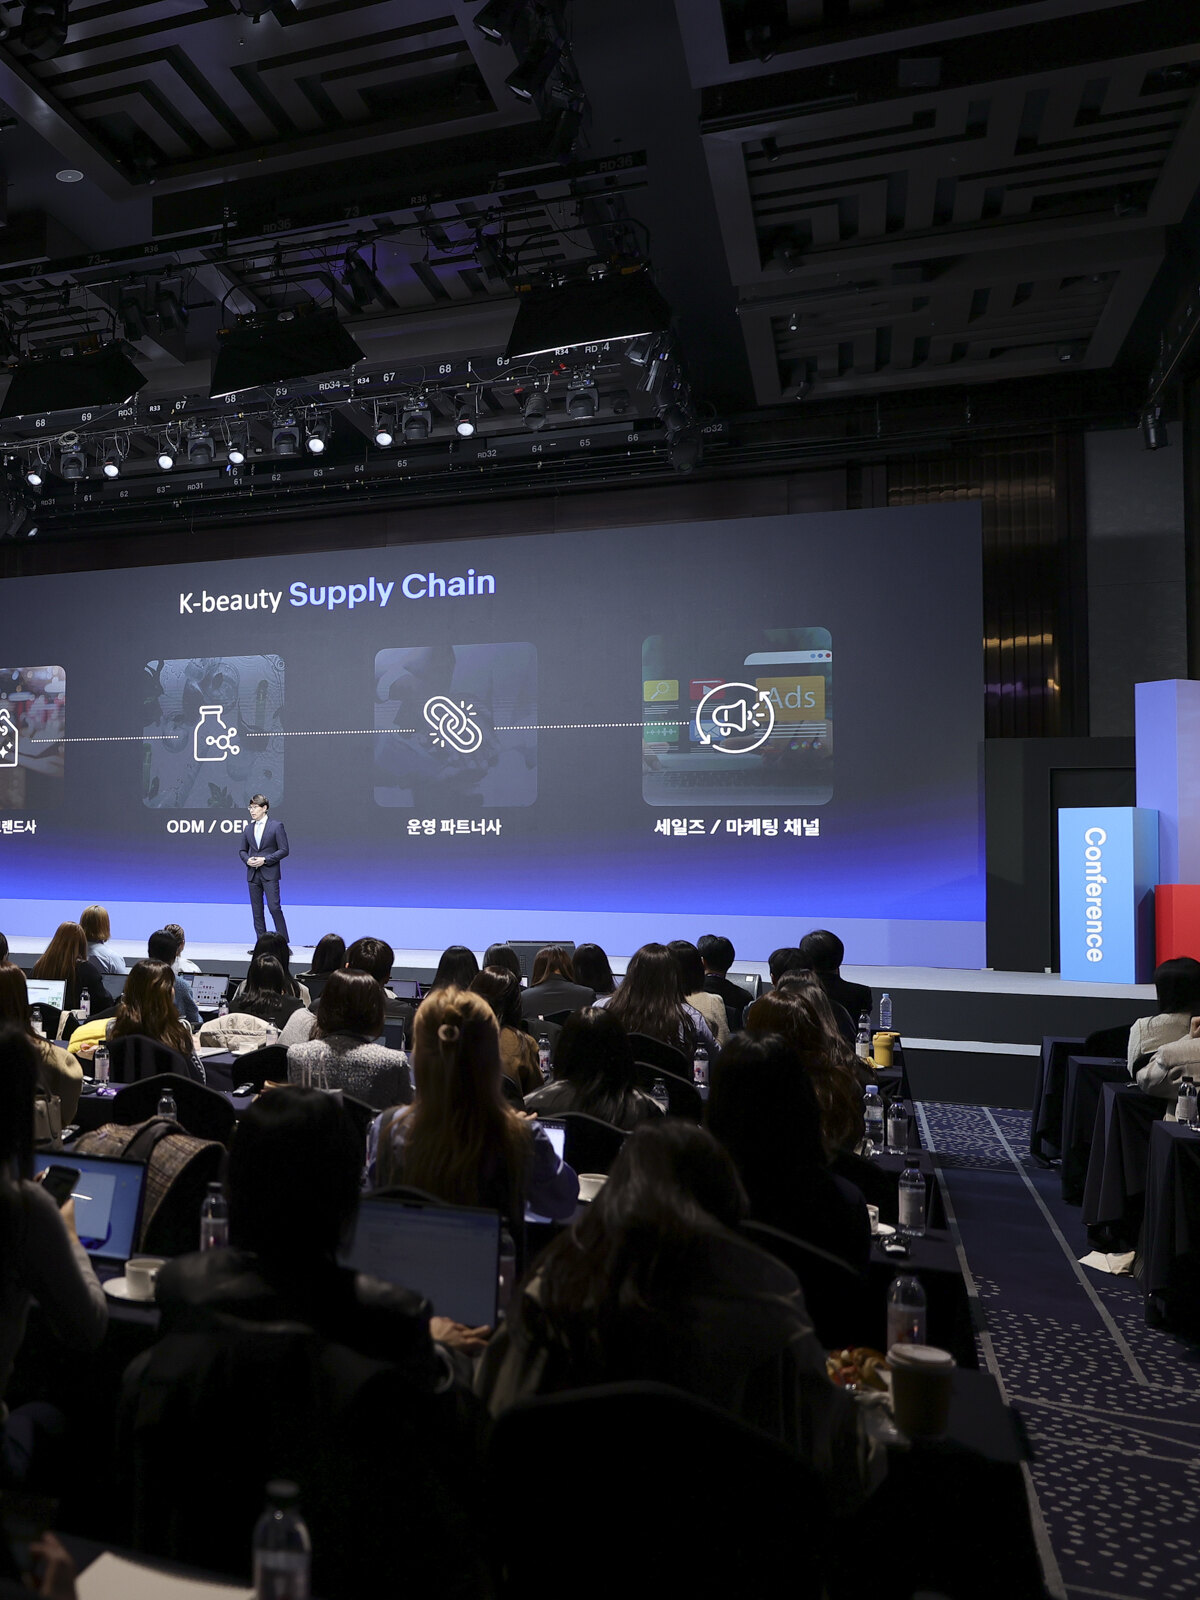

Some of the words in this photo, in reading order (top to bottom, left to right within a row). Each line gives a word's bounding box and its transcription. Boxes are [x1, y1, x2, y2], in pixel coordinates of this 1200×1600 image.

[600, 155, 633, 171] RD36
[489, 180, 505, 192] 75
[411, 194, 427, 205] R36
[263, 218, 291, 232] RD36
[144, 244, 158, 253] R36
[88, 255, 100, 265] 73
[30, 265, 43, 275] 72
[555, 348, 569, 356] R34
[585, 342, 610, 354] RD4
[439, 364, 452, 374] 68
[357, 377, 370, 385] R34
[383, 372, 395, 382] 67
[319, 381, 341, 391] RD34
[276, 387, 288, 396] 69
[225, 395, 237, 404] 68
[149, 404, 161, 412] R33
[175, 400, 187, 410] 67
[81, 412, 92, 421] 69
[35, 419, 46, 428] 68
[579, 438, 591, 447] 65
[627, 433, 639, 443] 66
[531, 444, 543, 453] 64
[477, 449, 497, 459] RD32
[354, 464, 365, 473] 64
[397, 459, 408, 468] 65
[271, 474, 281, 482] 62
[313, 469, 323, 477] 63
[156, 486, 166, 494] 63
[187, 482, 204, 491] RD31
[84, 494, 92, 502] 61
[119, 490, 129, 498] 62
[179, 589, 283, 614] K-beauty
[289, 577, 394, 610] Supply
[402, 569, 496, 599] Chain
[764, 685, 816, 709] Ads
[166, 819, 205, 834] ODM
[207, 819, 217, 834] /
[406, 818, 437, 835] 운영
[440, 818, 502, 836] 파트너사
[653, 818, 706, 836] 세일즈
[710, 819, 721, 836] /
[726, 818, 779, 837] 마케팅
[783, 818, 820, 837] 채널
[1084, 827, 1108, 963] Conference
